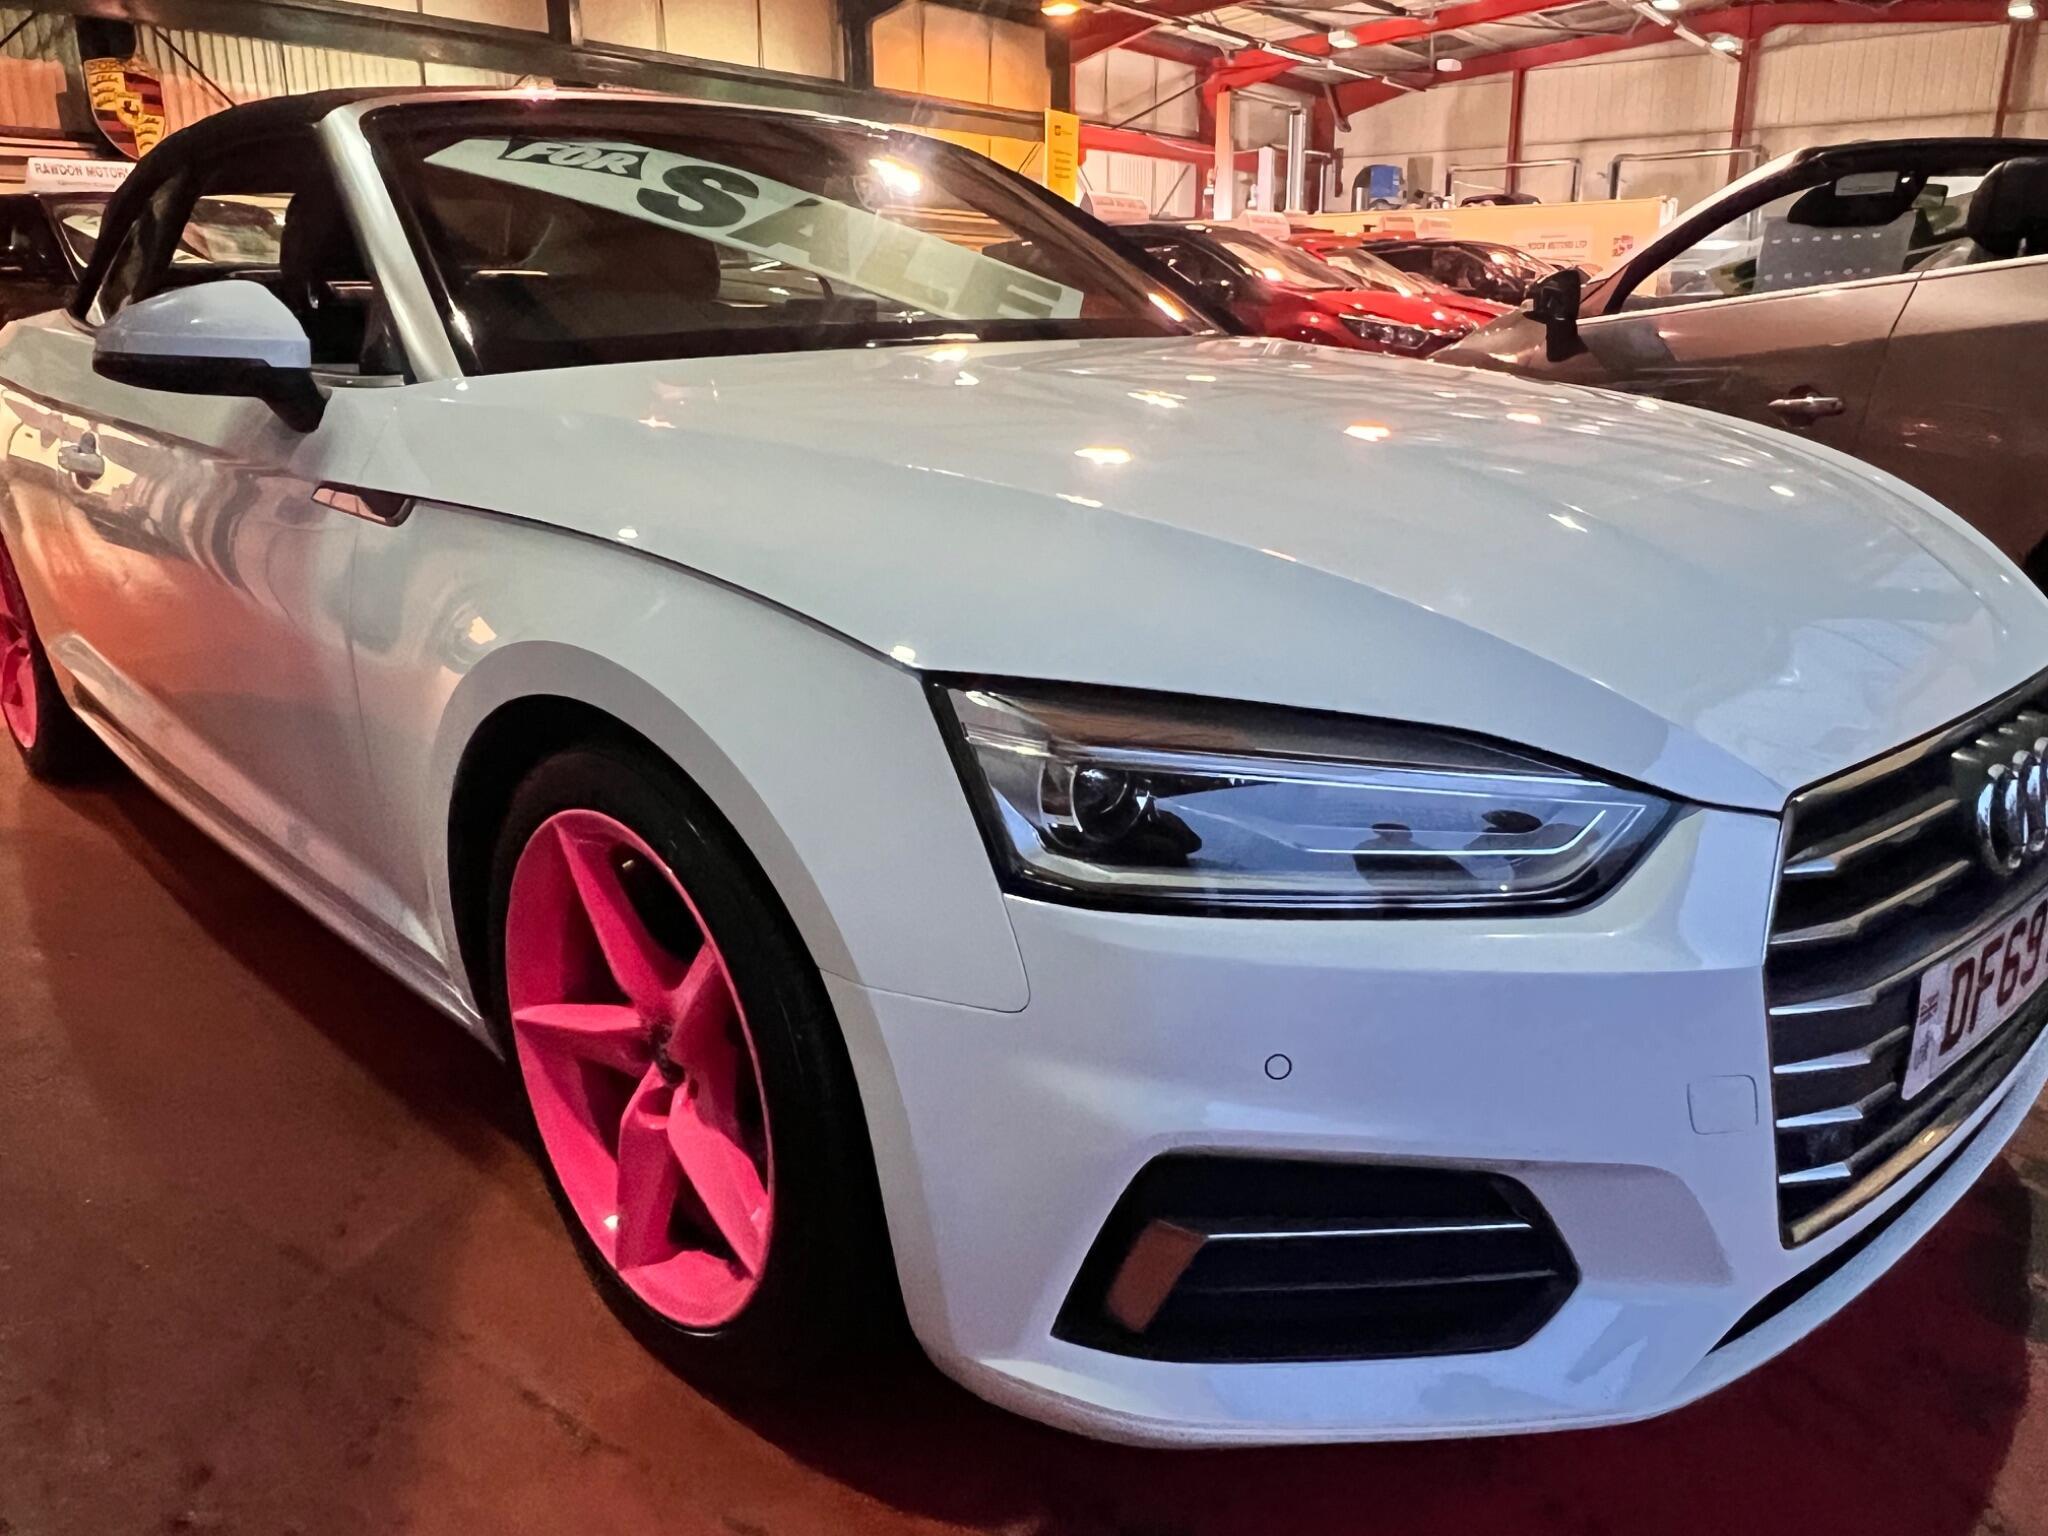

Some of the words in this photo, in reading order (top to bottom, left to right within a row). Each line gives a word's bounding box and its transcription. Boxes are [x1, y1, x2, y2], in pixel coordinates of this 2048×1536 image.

[505, 141, 639, 174] FOR
[637, 165, 1062, 319] SALE
[1939, 898, 2048, 1056] DF69
